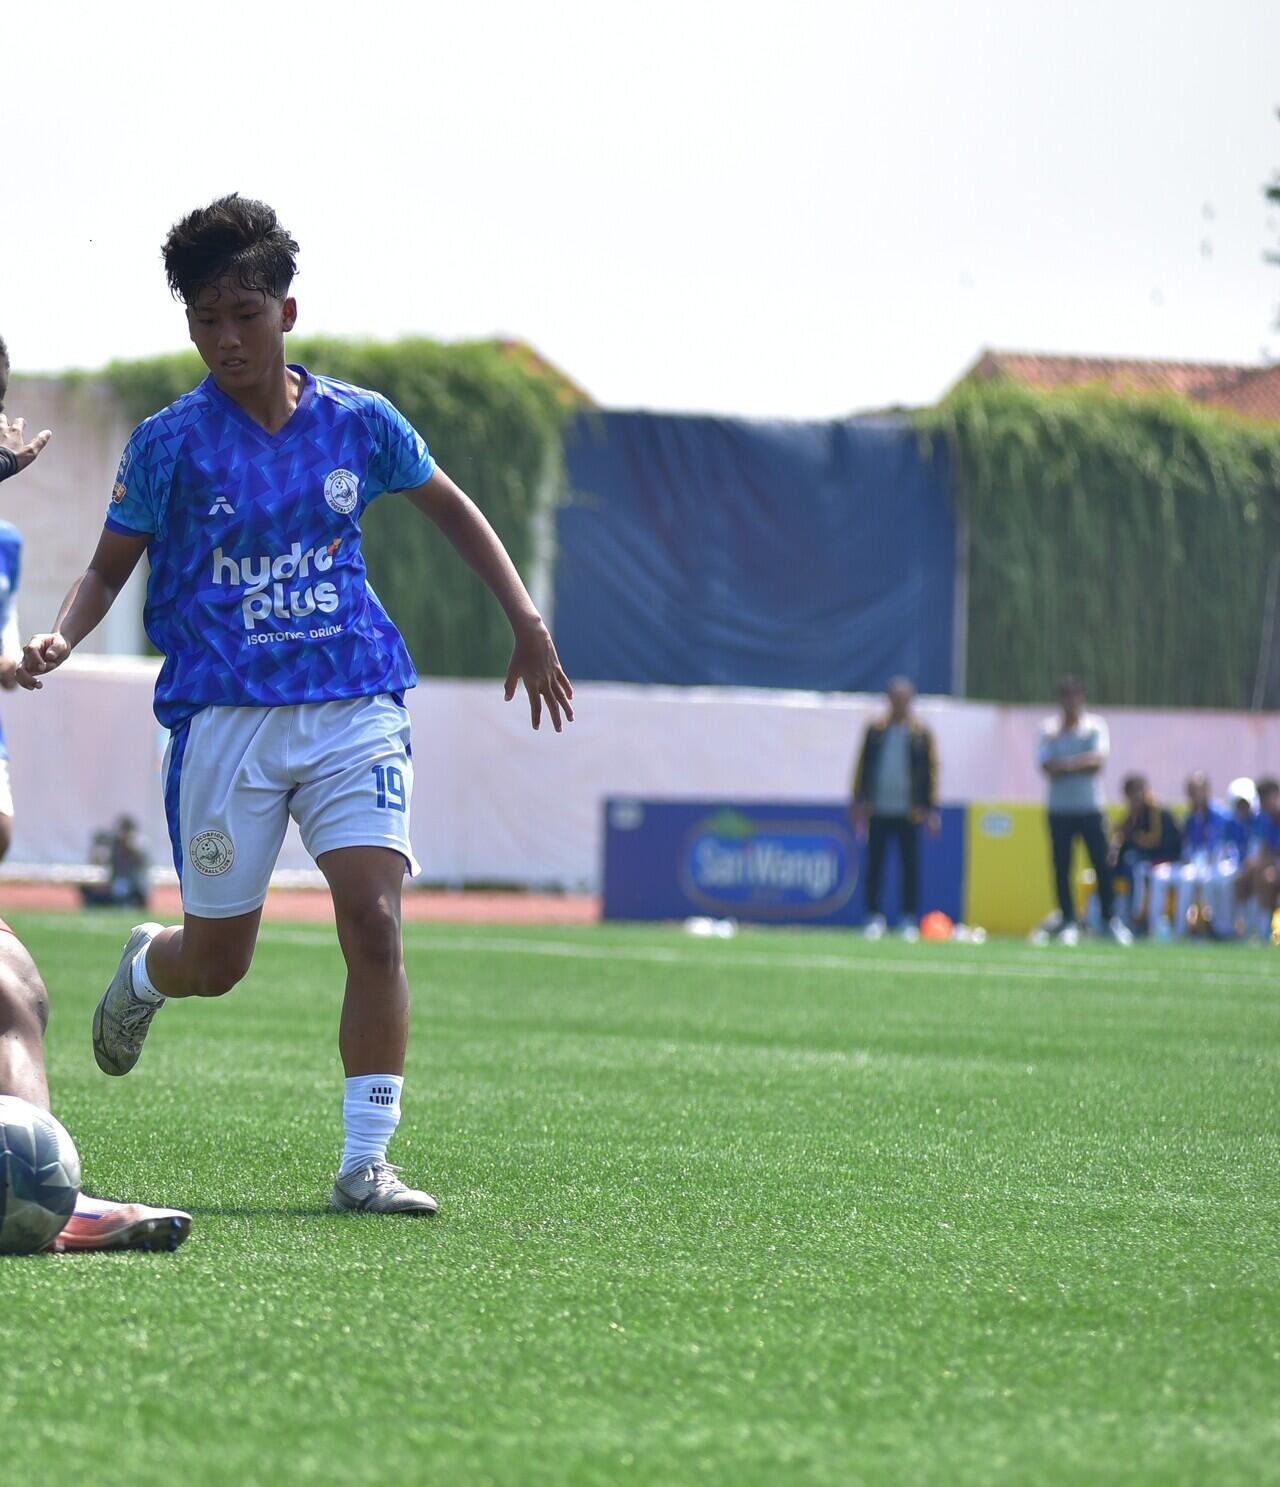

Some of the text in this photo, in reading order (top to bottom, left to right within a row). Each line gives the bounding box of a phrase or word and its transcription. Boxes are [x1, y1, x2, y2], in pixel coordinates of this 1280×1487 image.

[212, 542, 333, 596] hydro
[241, 582, 339, 630] plus
[247, 624, 344, 646] ISOTONIC DRINK
[372, 764, 406, 812] 19
